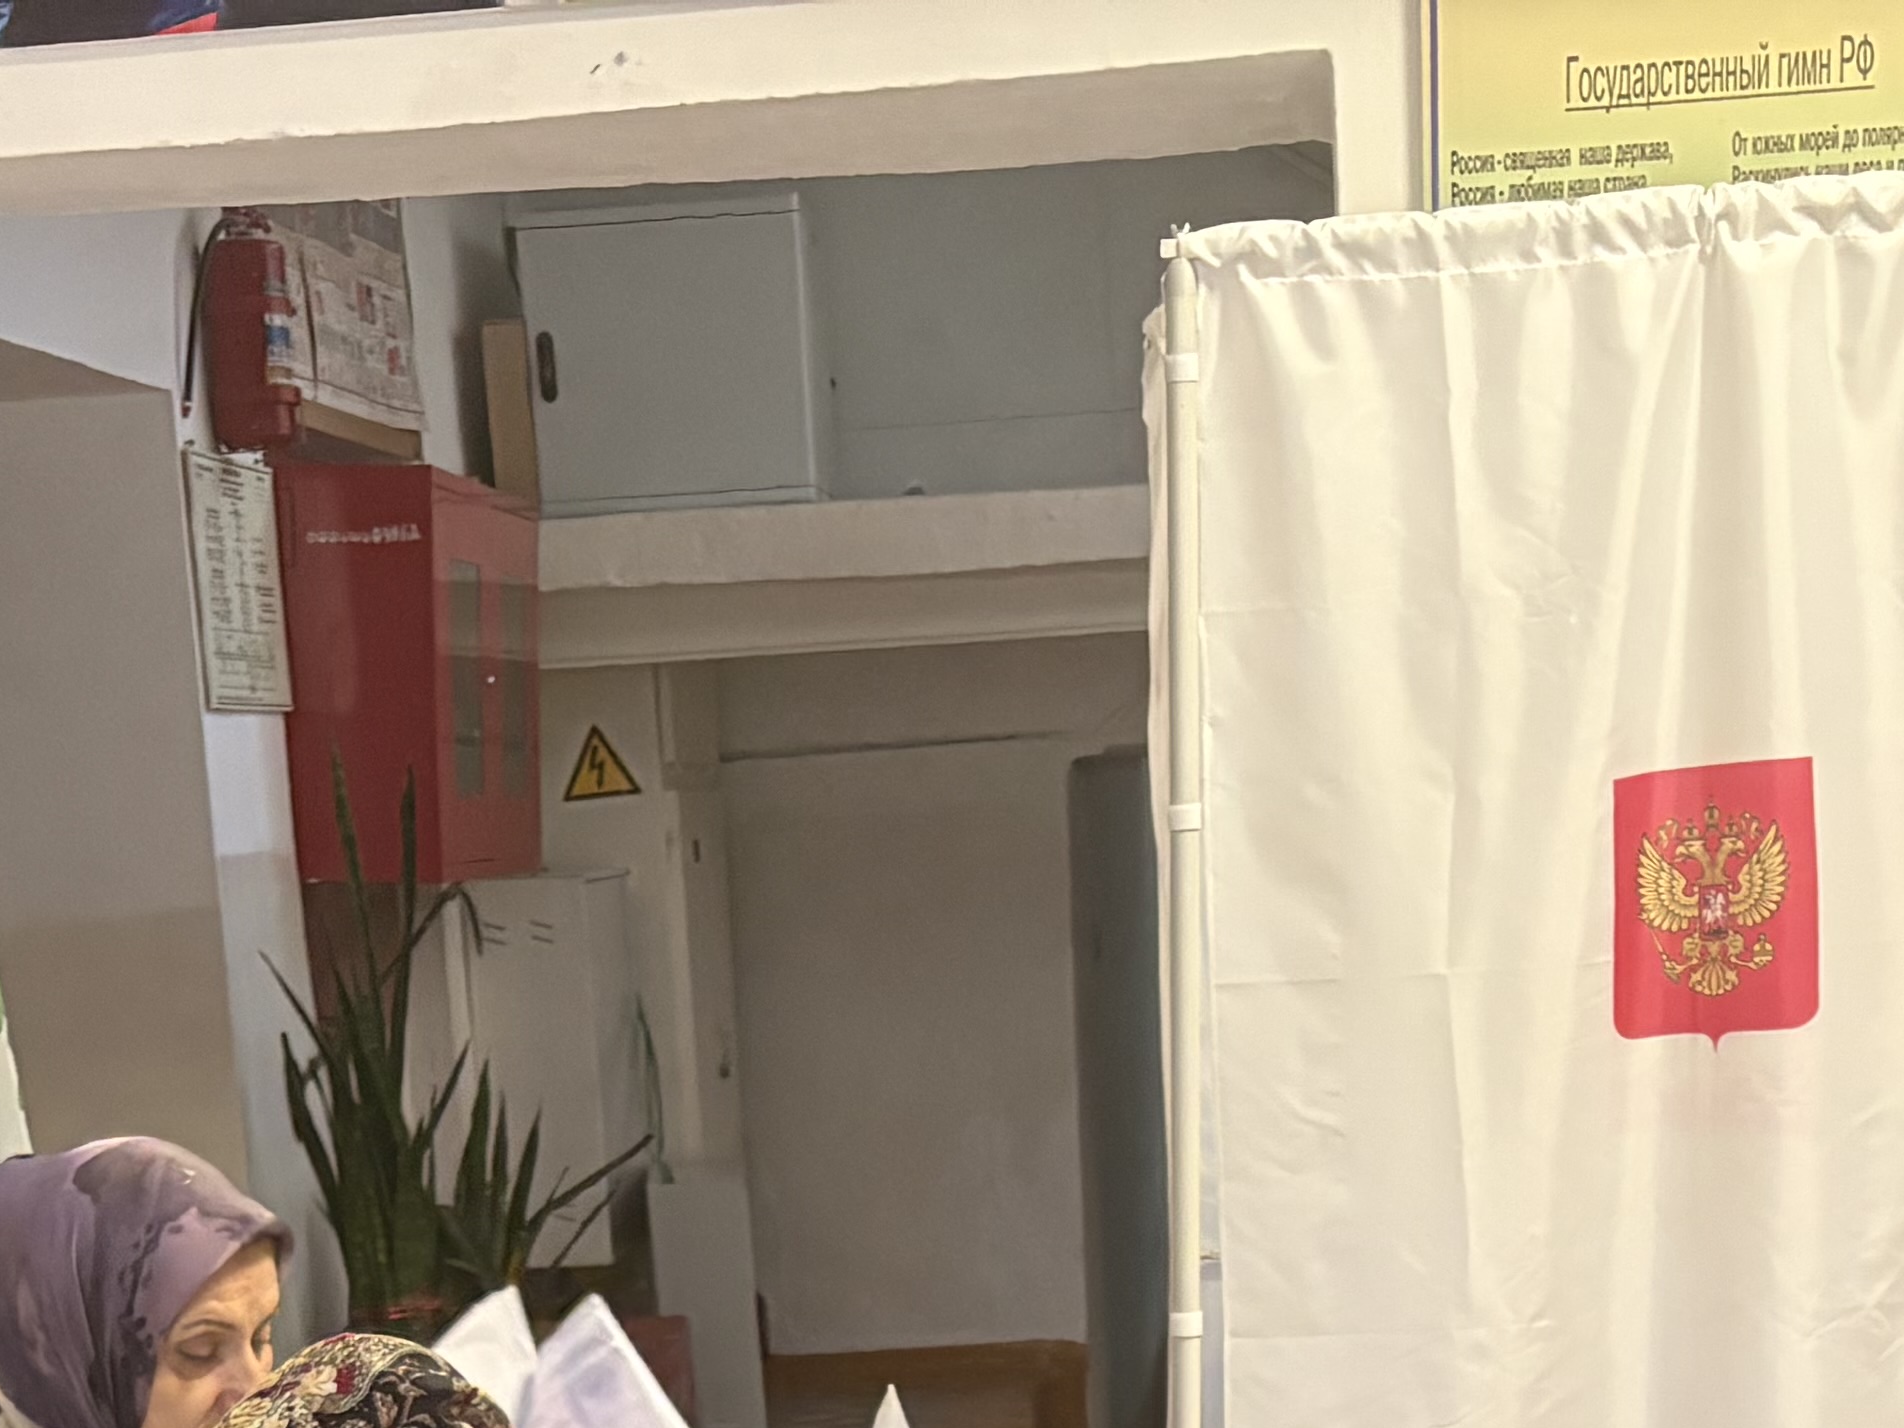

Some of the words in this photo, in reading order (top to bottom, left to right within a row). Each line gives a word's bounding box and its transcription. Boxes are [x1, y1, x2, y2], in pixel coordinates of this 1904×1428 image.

[1565, 41, 1770, 114] Государственный
[1779, 54, 1833, 88] гимн
[1840, 33, 1876, 83] РФ
[1579, 145, 1612, 166] наша
[1615, 141, 1674, 169] держава,
[1732, 131, 1748, 157] От
[1752, 134, 1795, 155] южных
[1799, 125, 1839, 156] морей
[1842, 130, 1859, 152] до
